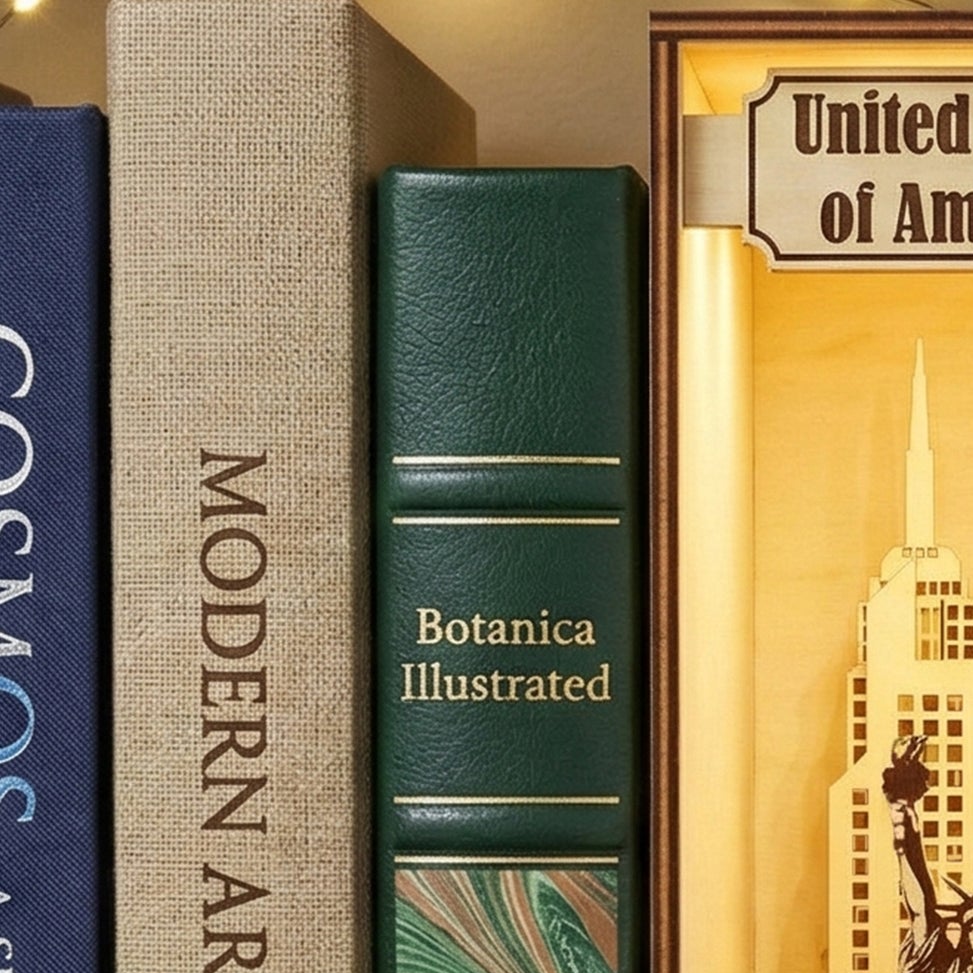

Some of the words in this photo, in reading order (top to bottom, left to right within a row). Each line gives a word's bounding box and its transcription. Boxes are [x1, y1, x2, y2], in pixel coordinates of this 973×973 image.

[792, 89, 972, 155] United
[820, 181, 875, 244] of
[200, 448, 268, 834] MODERN
[416, 608, 596, 645] Botanica
[400, 661, 611, 702] Illustrated
